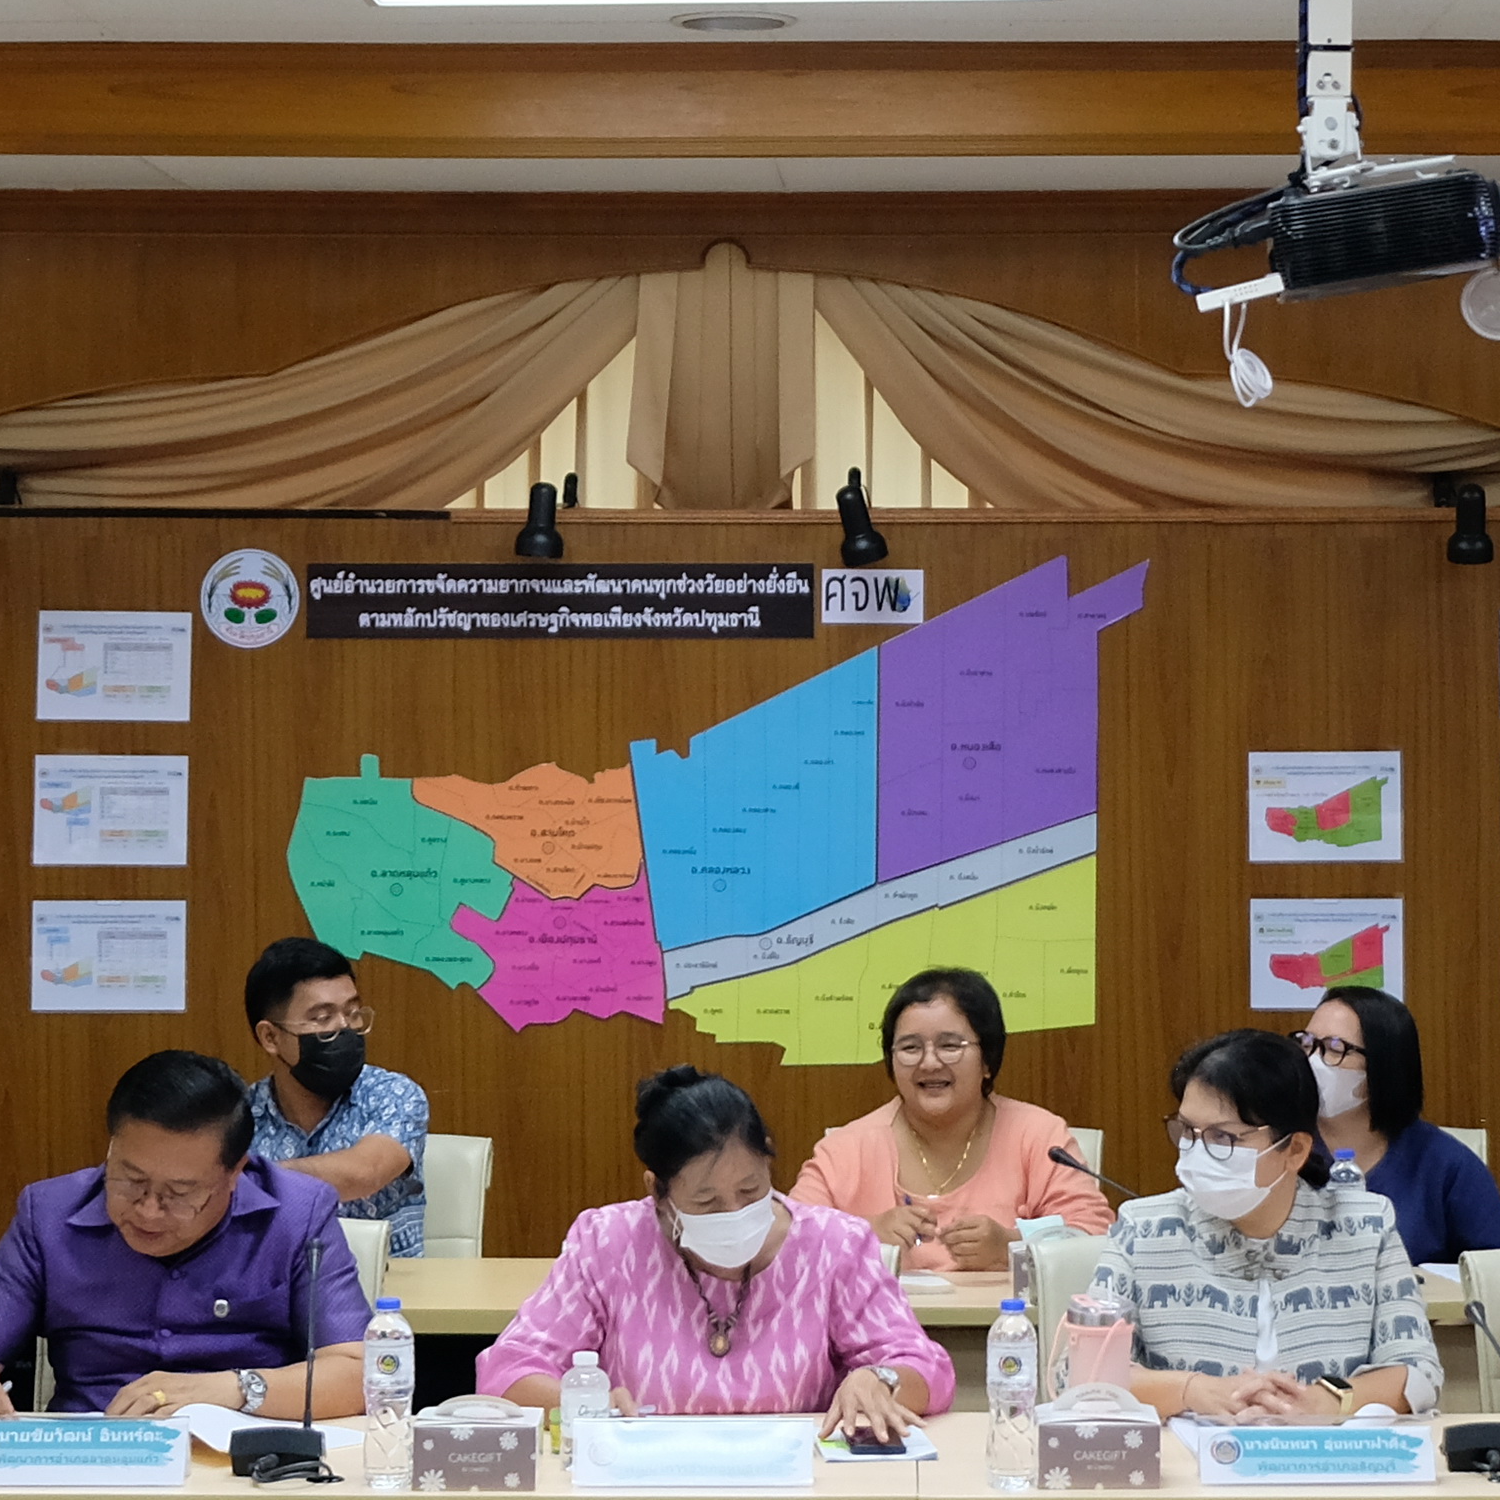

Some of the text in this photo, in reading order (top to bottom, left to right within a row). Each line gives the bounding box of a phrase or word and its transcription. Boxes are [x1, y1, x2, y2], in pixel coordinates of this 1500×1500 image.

[309, 567, 810, 600] ศูนย์อำนวยการขจัดความยากจนและพัฒนาคนทุกช่วงวัยอย่างยั่งยืน
[825, 574, 901, 612] ศจพ
[358, 606, 761, 633] ตามหลักปรัชญาของเศรษฐกิจพอเพียงจังหวัดปทุมธานี
[448, 1452, 503, 1463] CAKEGIFT
[1073, 1450, 1128, 1461] CAKEGIFT
